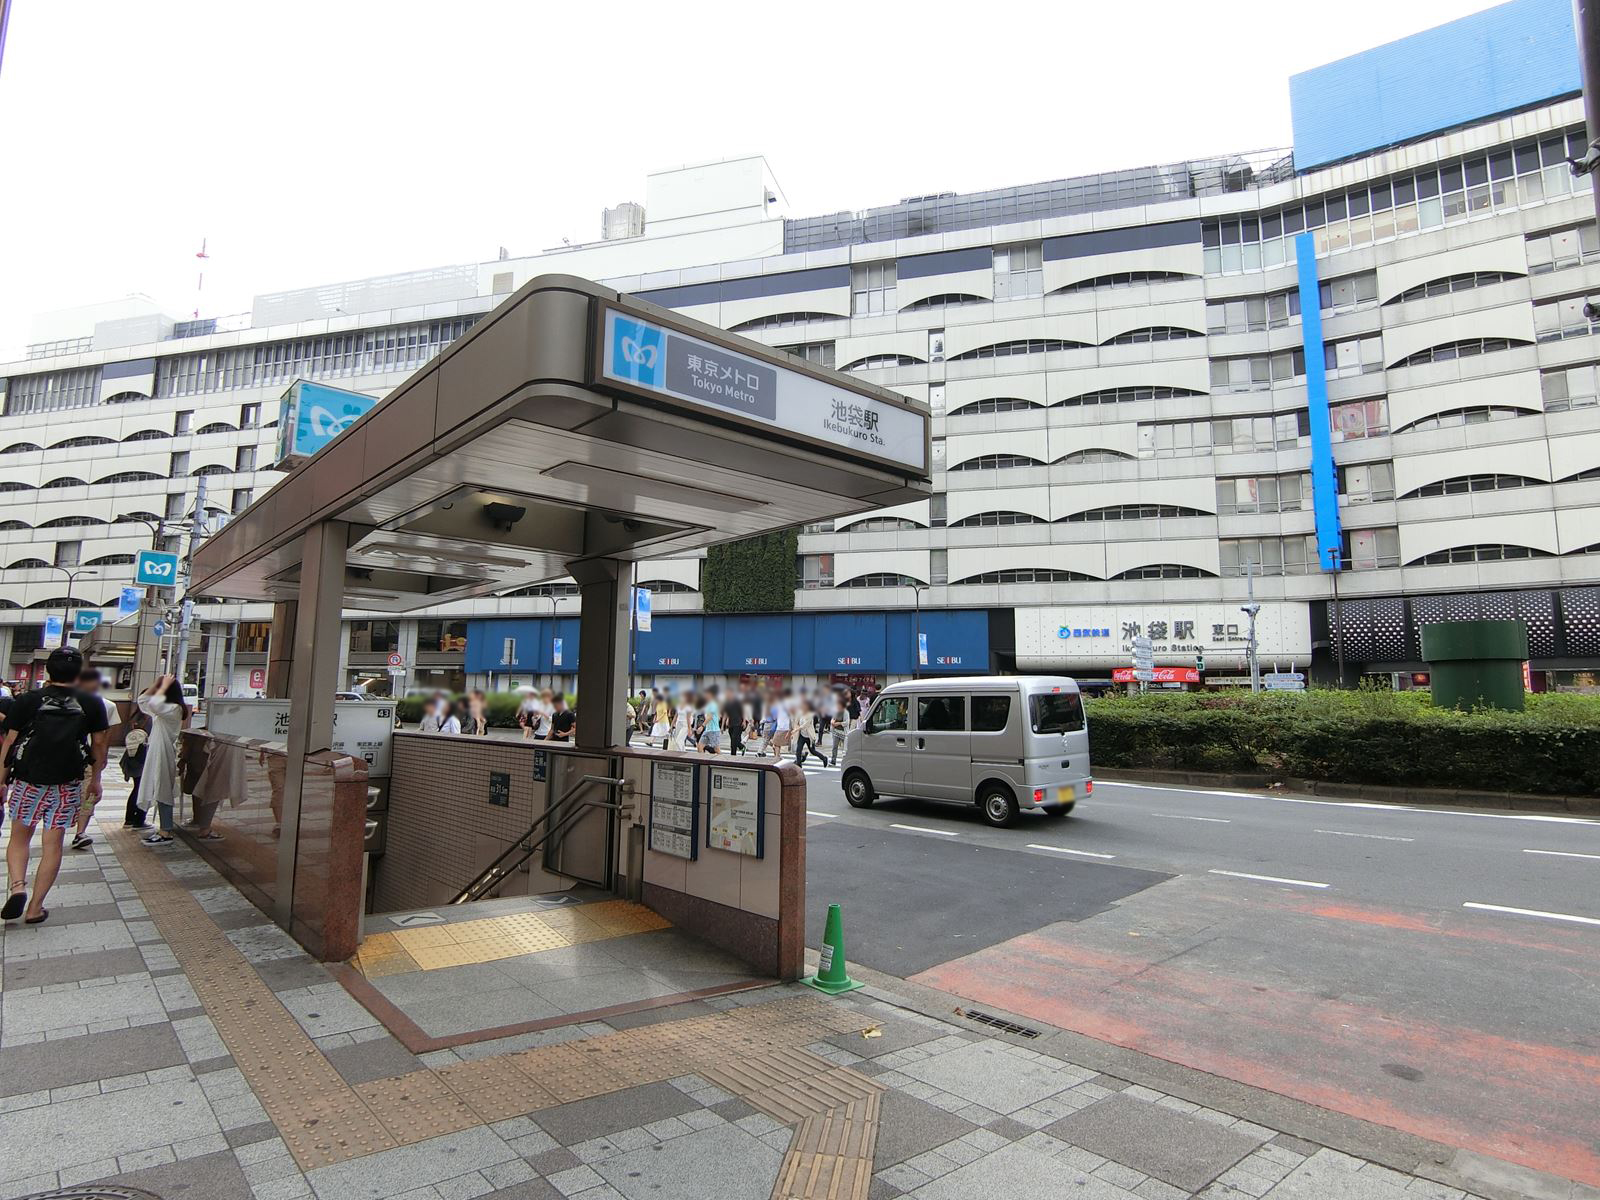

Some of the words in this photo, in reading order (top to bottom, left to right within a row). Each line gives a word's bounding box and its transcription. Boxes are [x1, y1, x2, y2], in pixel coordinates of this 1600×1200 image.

[687, 353, 760, 391] 東京メトロ
[691, 375, 722, 395] Tokyo
[724, 385, 755, 404] Metro
[831, 398, 879, 432] 池袋駅
[823, 418, 868, 442] Ikebukuro
[869, 433, 886, 447] Sta.
[1212, 623, 1239, 636] 東口
[658, 657, 680, 665] SEIBU
[745, 657, 767, 665] SEIBU
[837, 657, 861, 665] SEIBU
[936, 656, 961, 665] SEIBU
[378, 710, 389, 718] 43
